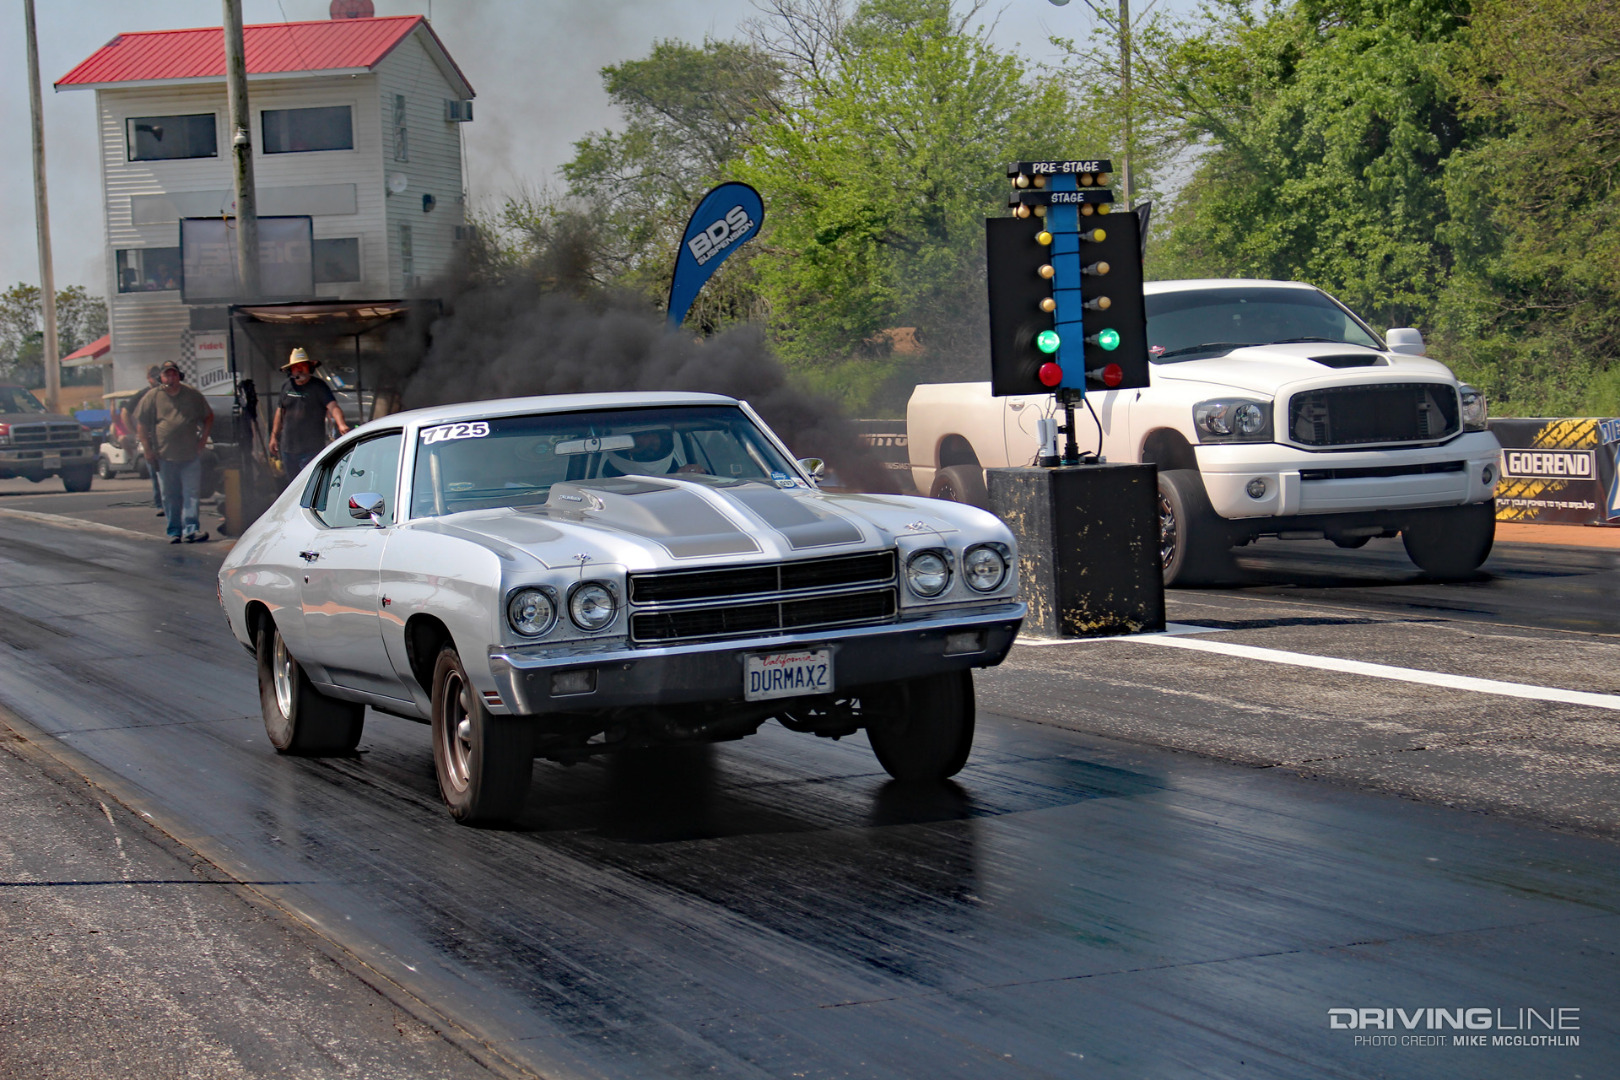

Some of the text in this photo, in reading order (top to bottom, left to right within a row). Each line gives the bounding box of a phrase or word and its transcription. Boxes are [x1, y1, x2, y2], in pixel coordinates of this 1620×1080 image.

[1032, 161, 1099, 173] PRE-STAGE
[1051, 192, 1084, 203] STAGE
[687, 205, 749, 259] BDS
[697, 219, 754, 266] SUSPENSION
[423, 424, 487, 442] 7725
[1509, 452, 1591, 475] GOEREND
[1496, 499, 1510, 508] PUT
[1511, 500, 1526, 508] YOUR
[1555, 502, 1568, 510] THE
[763, 653, 816, 667] California
[750, 664, 828, 693] DURMAX2
